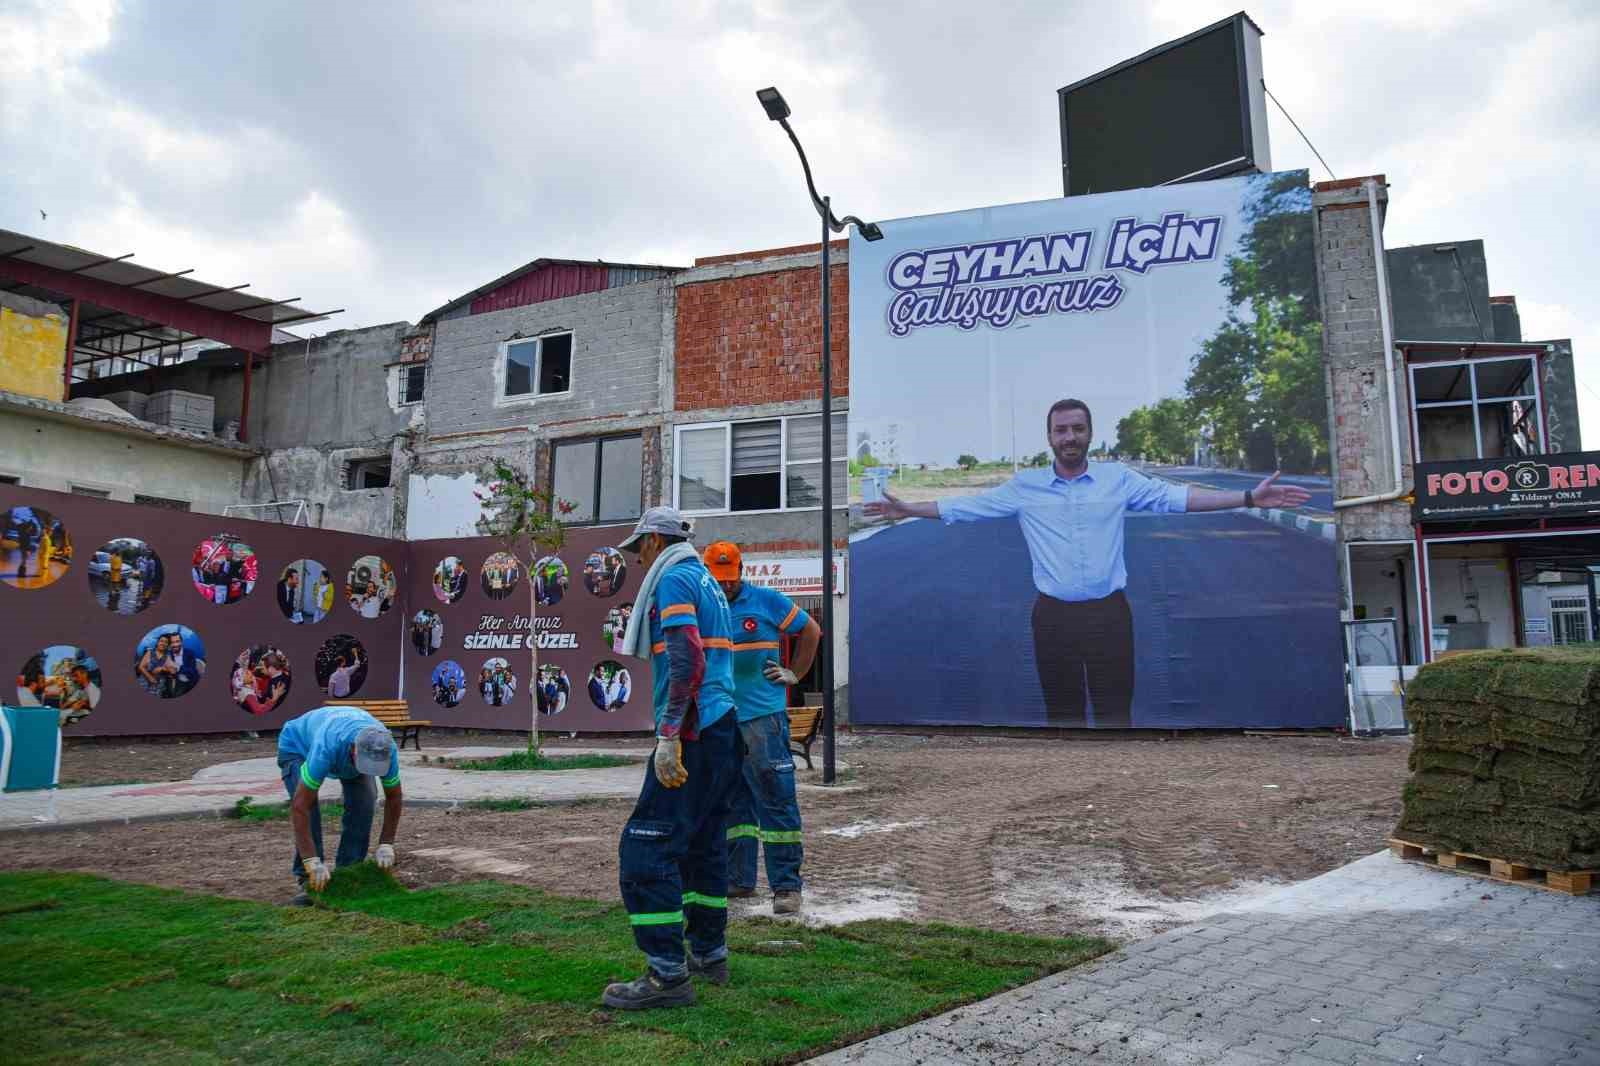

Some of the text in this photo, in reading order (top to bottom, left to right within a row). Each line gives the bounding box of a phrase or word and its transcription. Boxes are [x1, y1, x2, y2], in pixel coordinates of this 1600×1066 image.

[889, 213, 1221, 290] CEYHAN İÇİN
[889, 276, 1123, 335] Çalışıyoruz
[1427, 469, 1509, 496] FOTO
[479, 615, 504, 630] Her
[464, 631, 522, 649] SİZİNLE
